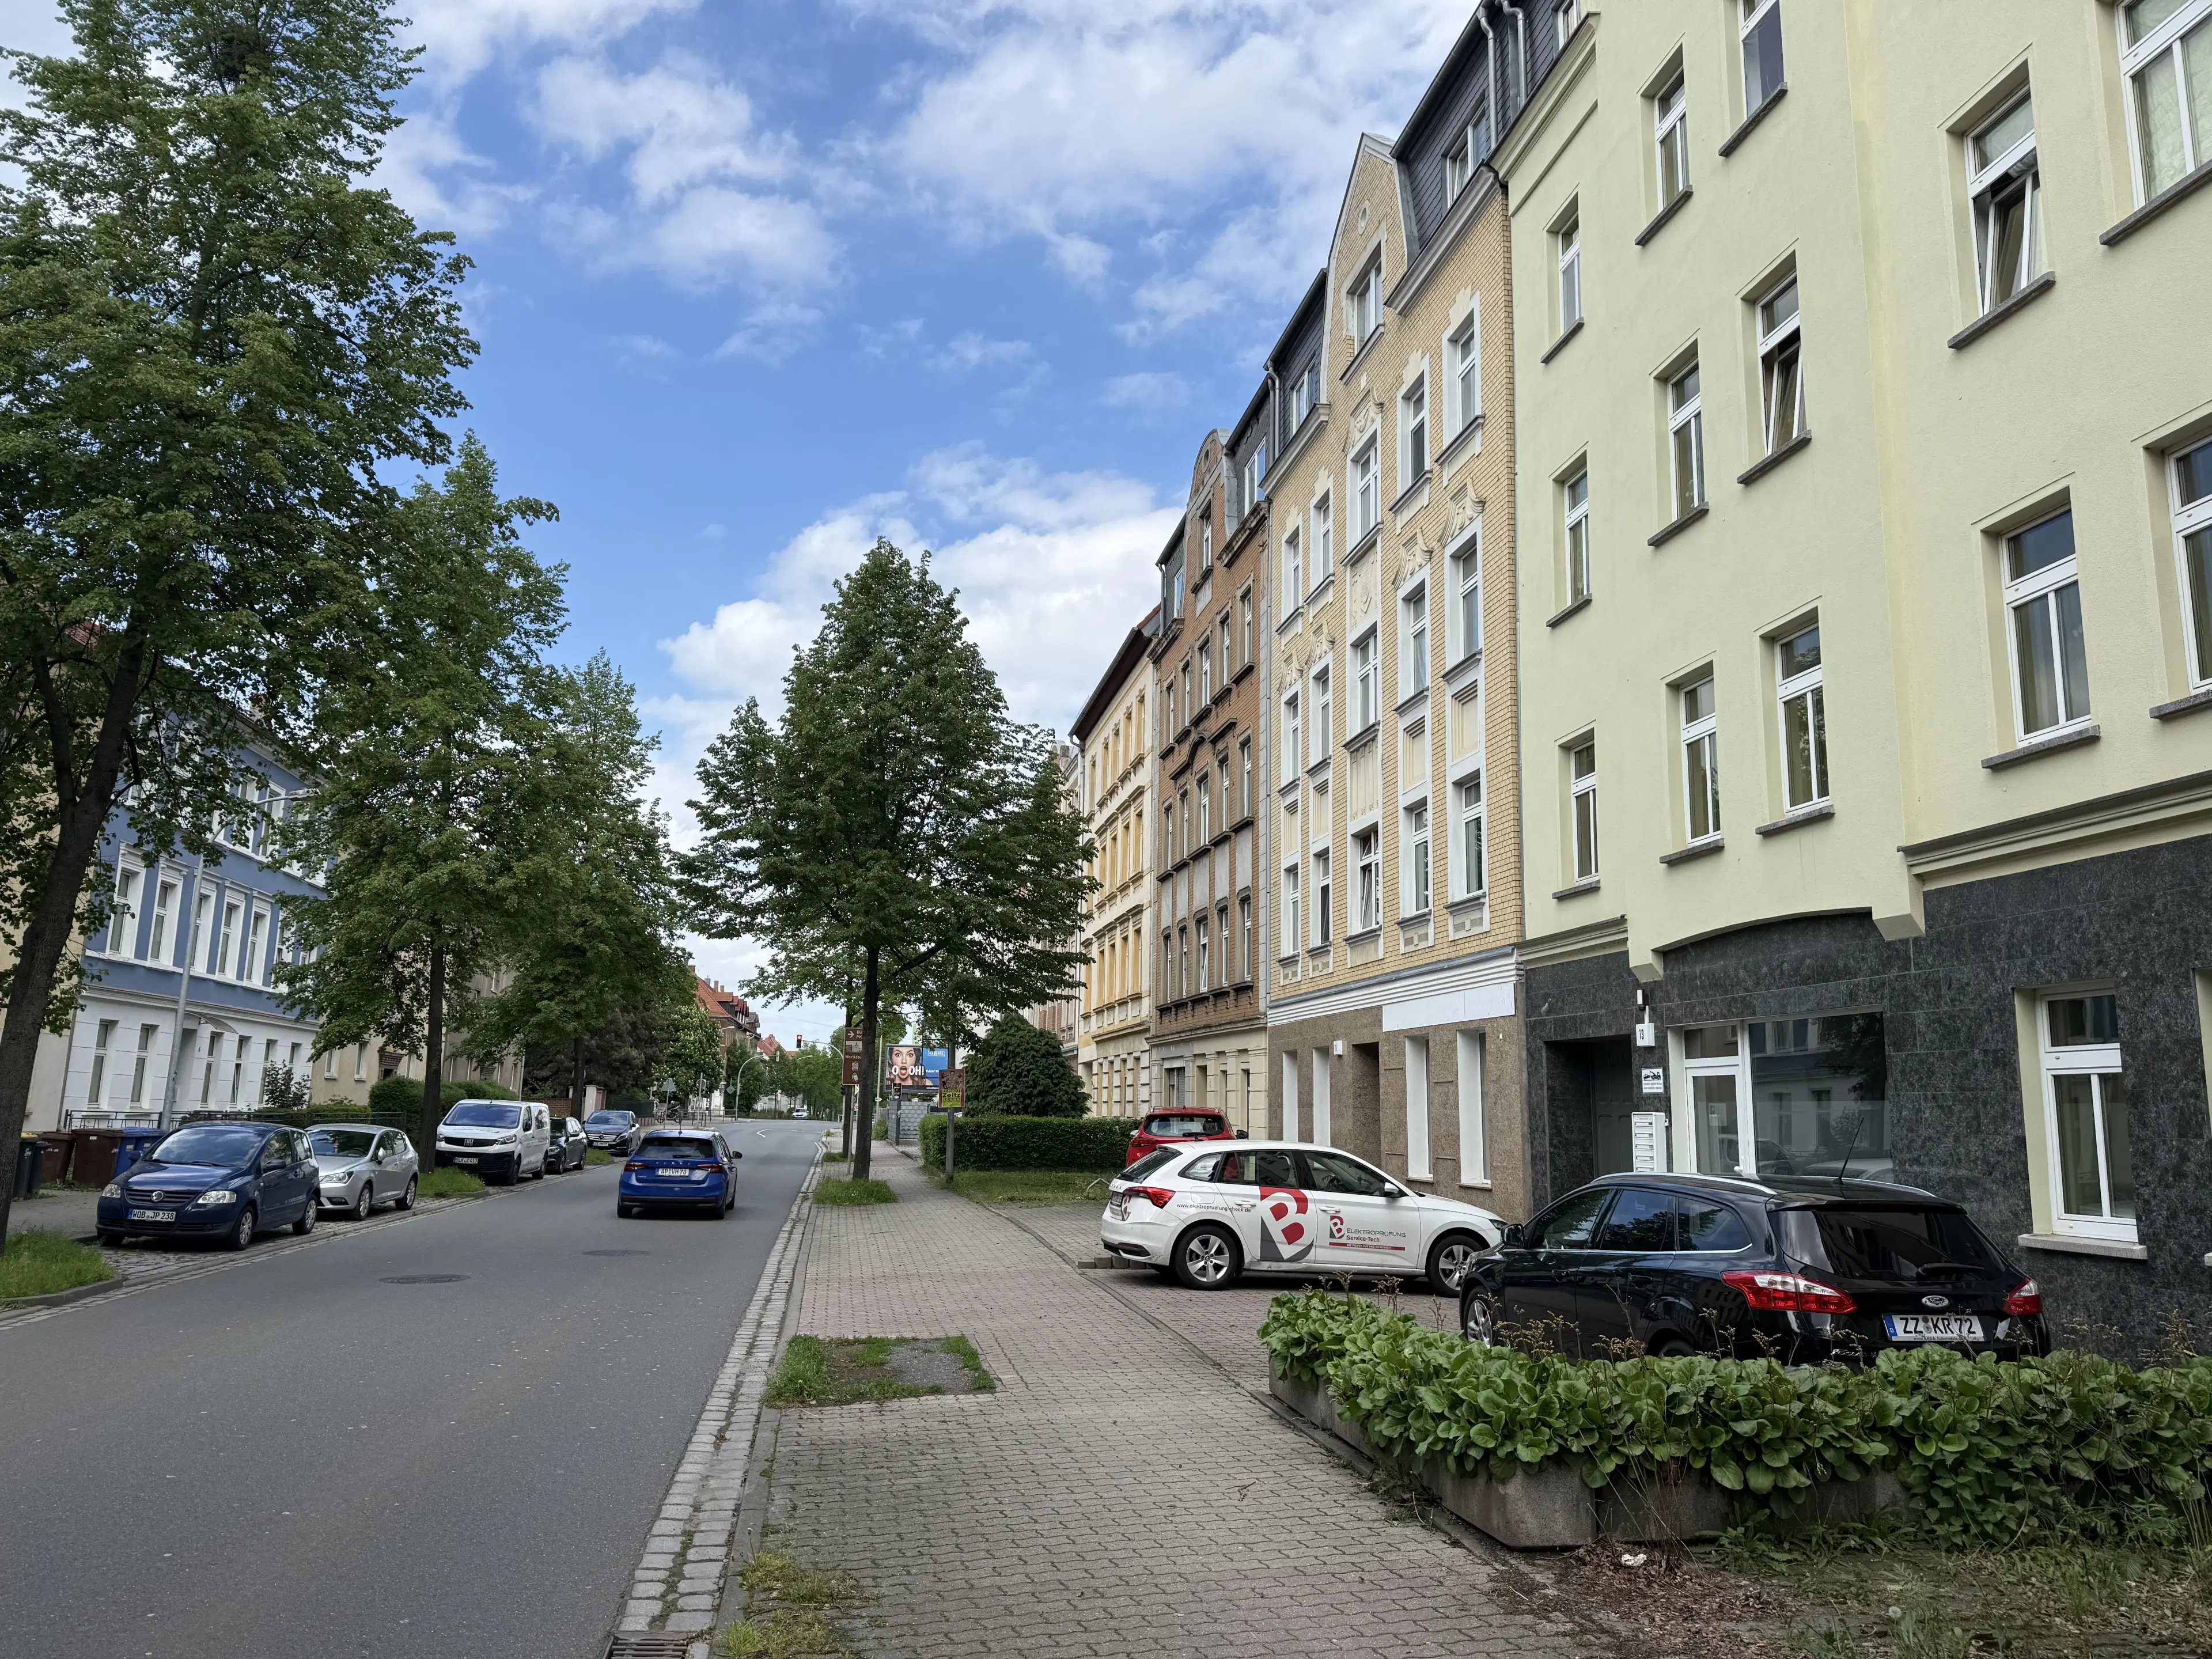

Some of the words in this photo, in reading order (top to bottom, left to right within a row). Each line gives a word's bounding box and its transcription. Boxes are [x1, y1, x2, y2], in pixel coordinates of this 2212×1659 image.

[1639, 1029, 1644, 1040] 13
[908, 1065, 925, 1075] OH!
[132, 1210, 146, 1218] WOB
[161, 1212, 174, 1220] 238
[1899, 1317, 1923, 1334] ZZ
[1930, 1317, 1955, 1334] KR
[1953, 1317, 1976, 1334] 72
